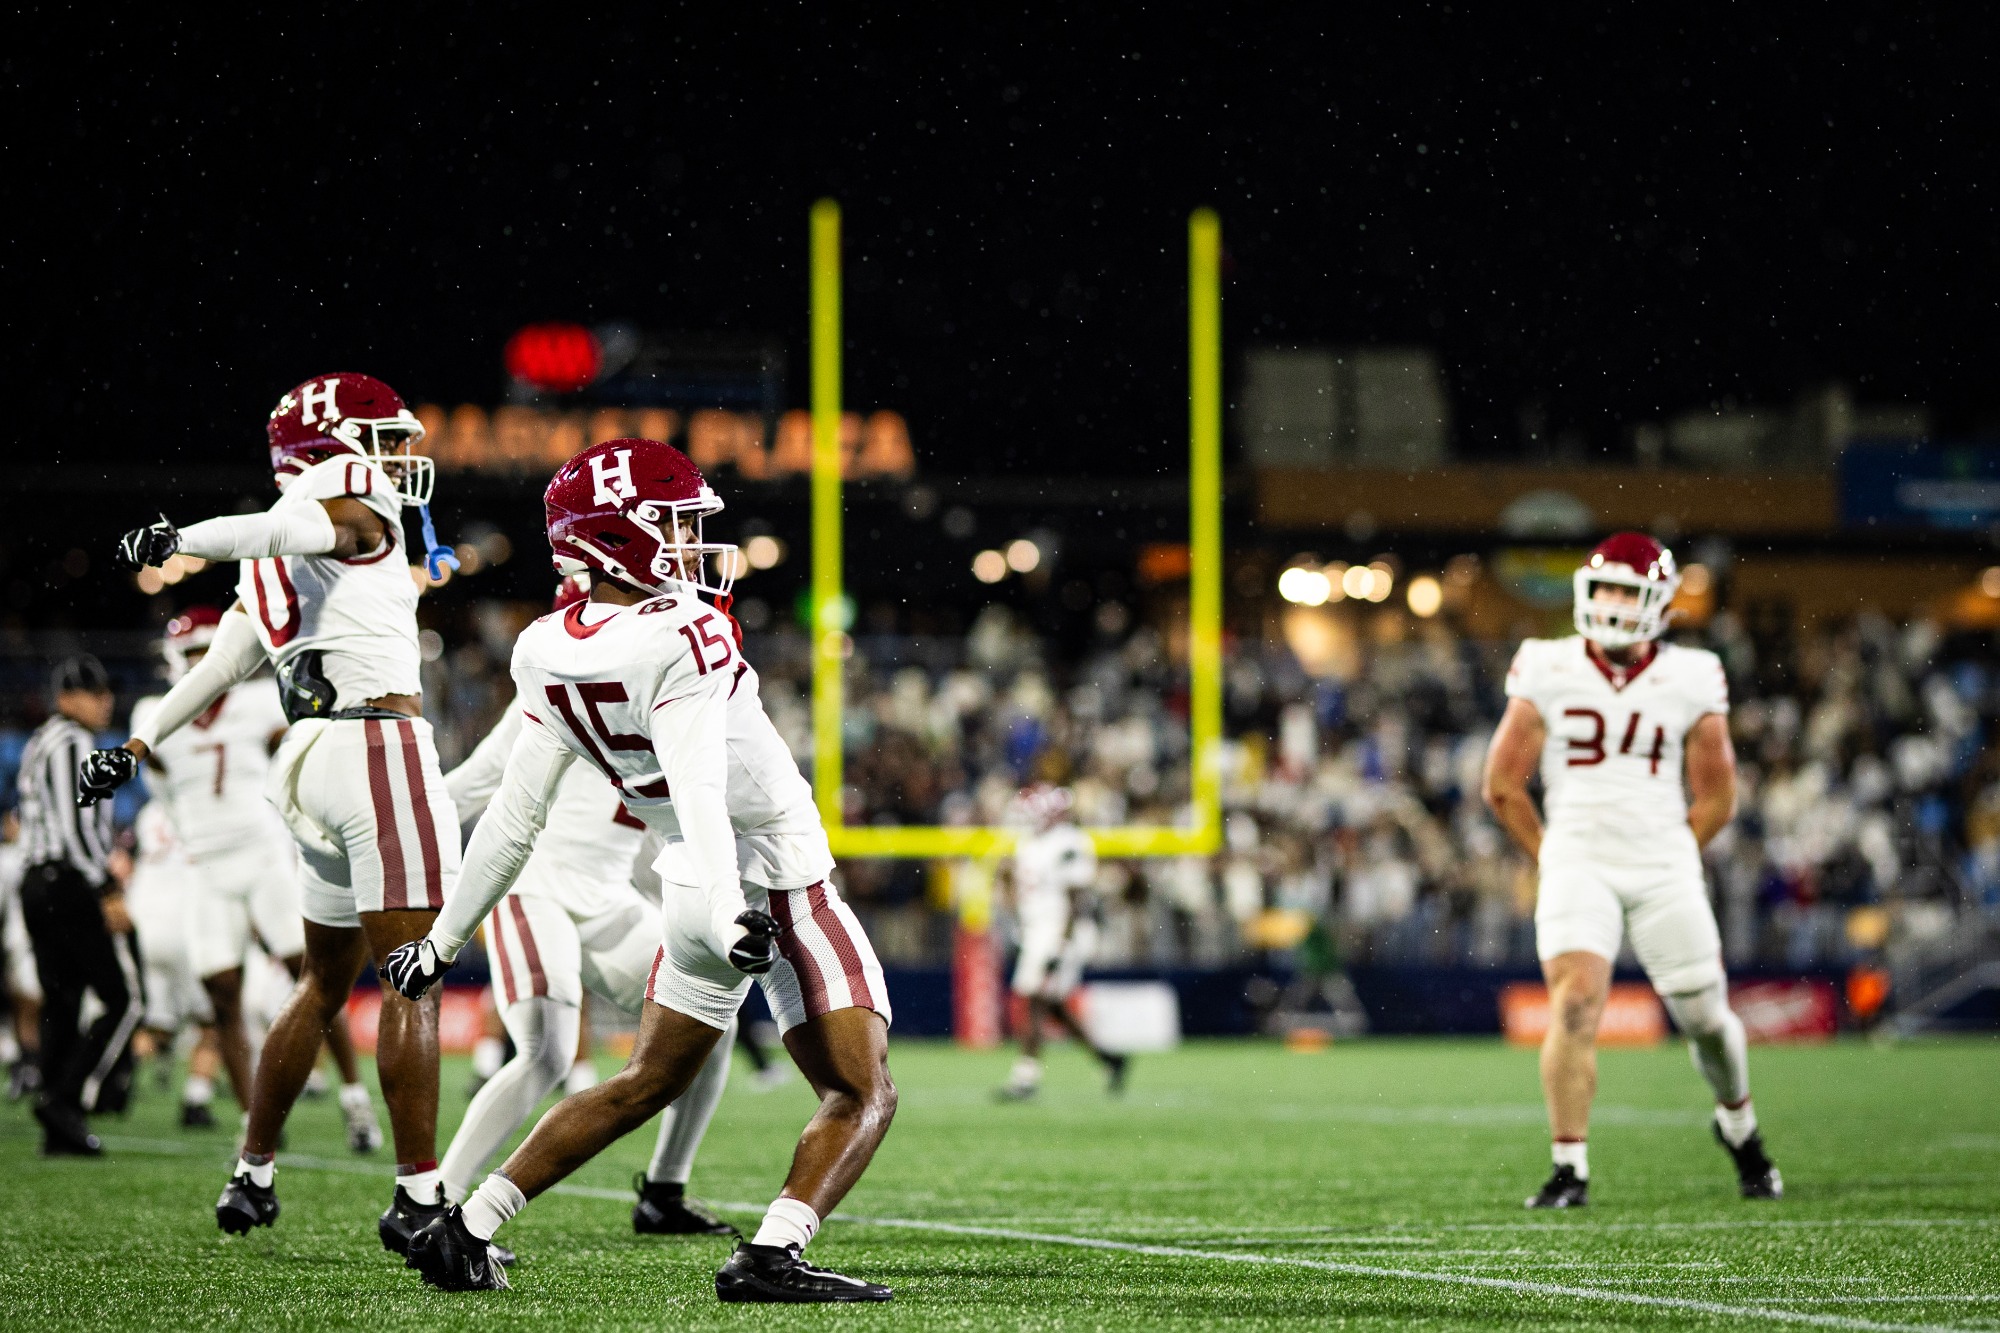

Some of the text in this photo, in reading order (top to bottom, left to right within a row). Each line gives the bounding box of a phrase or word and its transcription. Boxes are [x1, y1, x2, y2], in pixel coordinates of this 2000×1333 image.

[301, 378, 342, 426] H
[345, 462, 372, 495] 0
[588, 449, 638, 507] H
[678, 613, 732, 676] 15
[544, 681, 671, 799] 15
[1563, 708, 1666, 776] 34
[192, 742, 226, 797] 7
